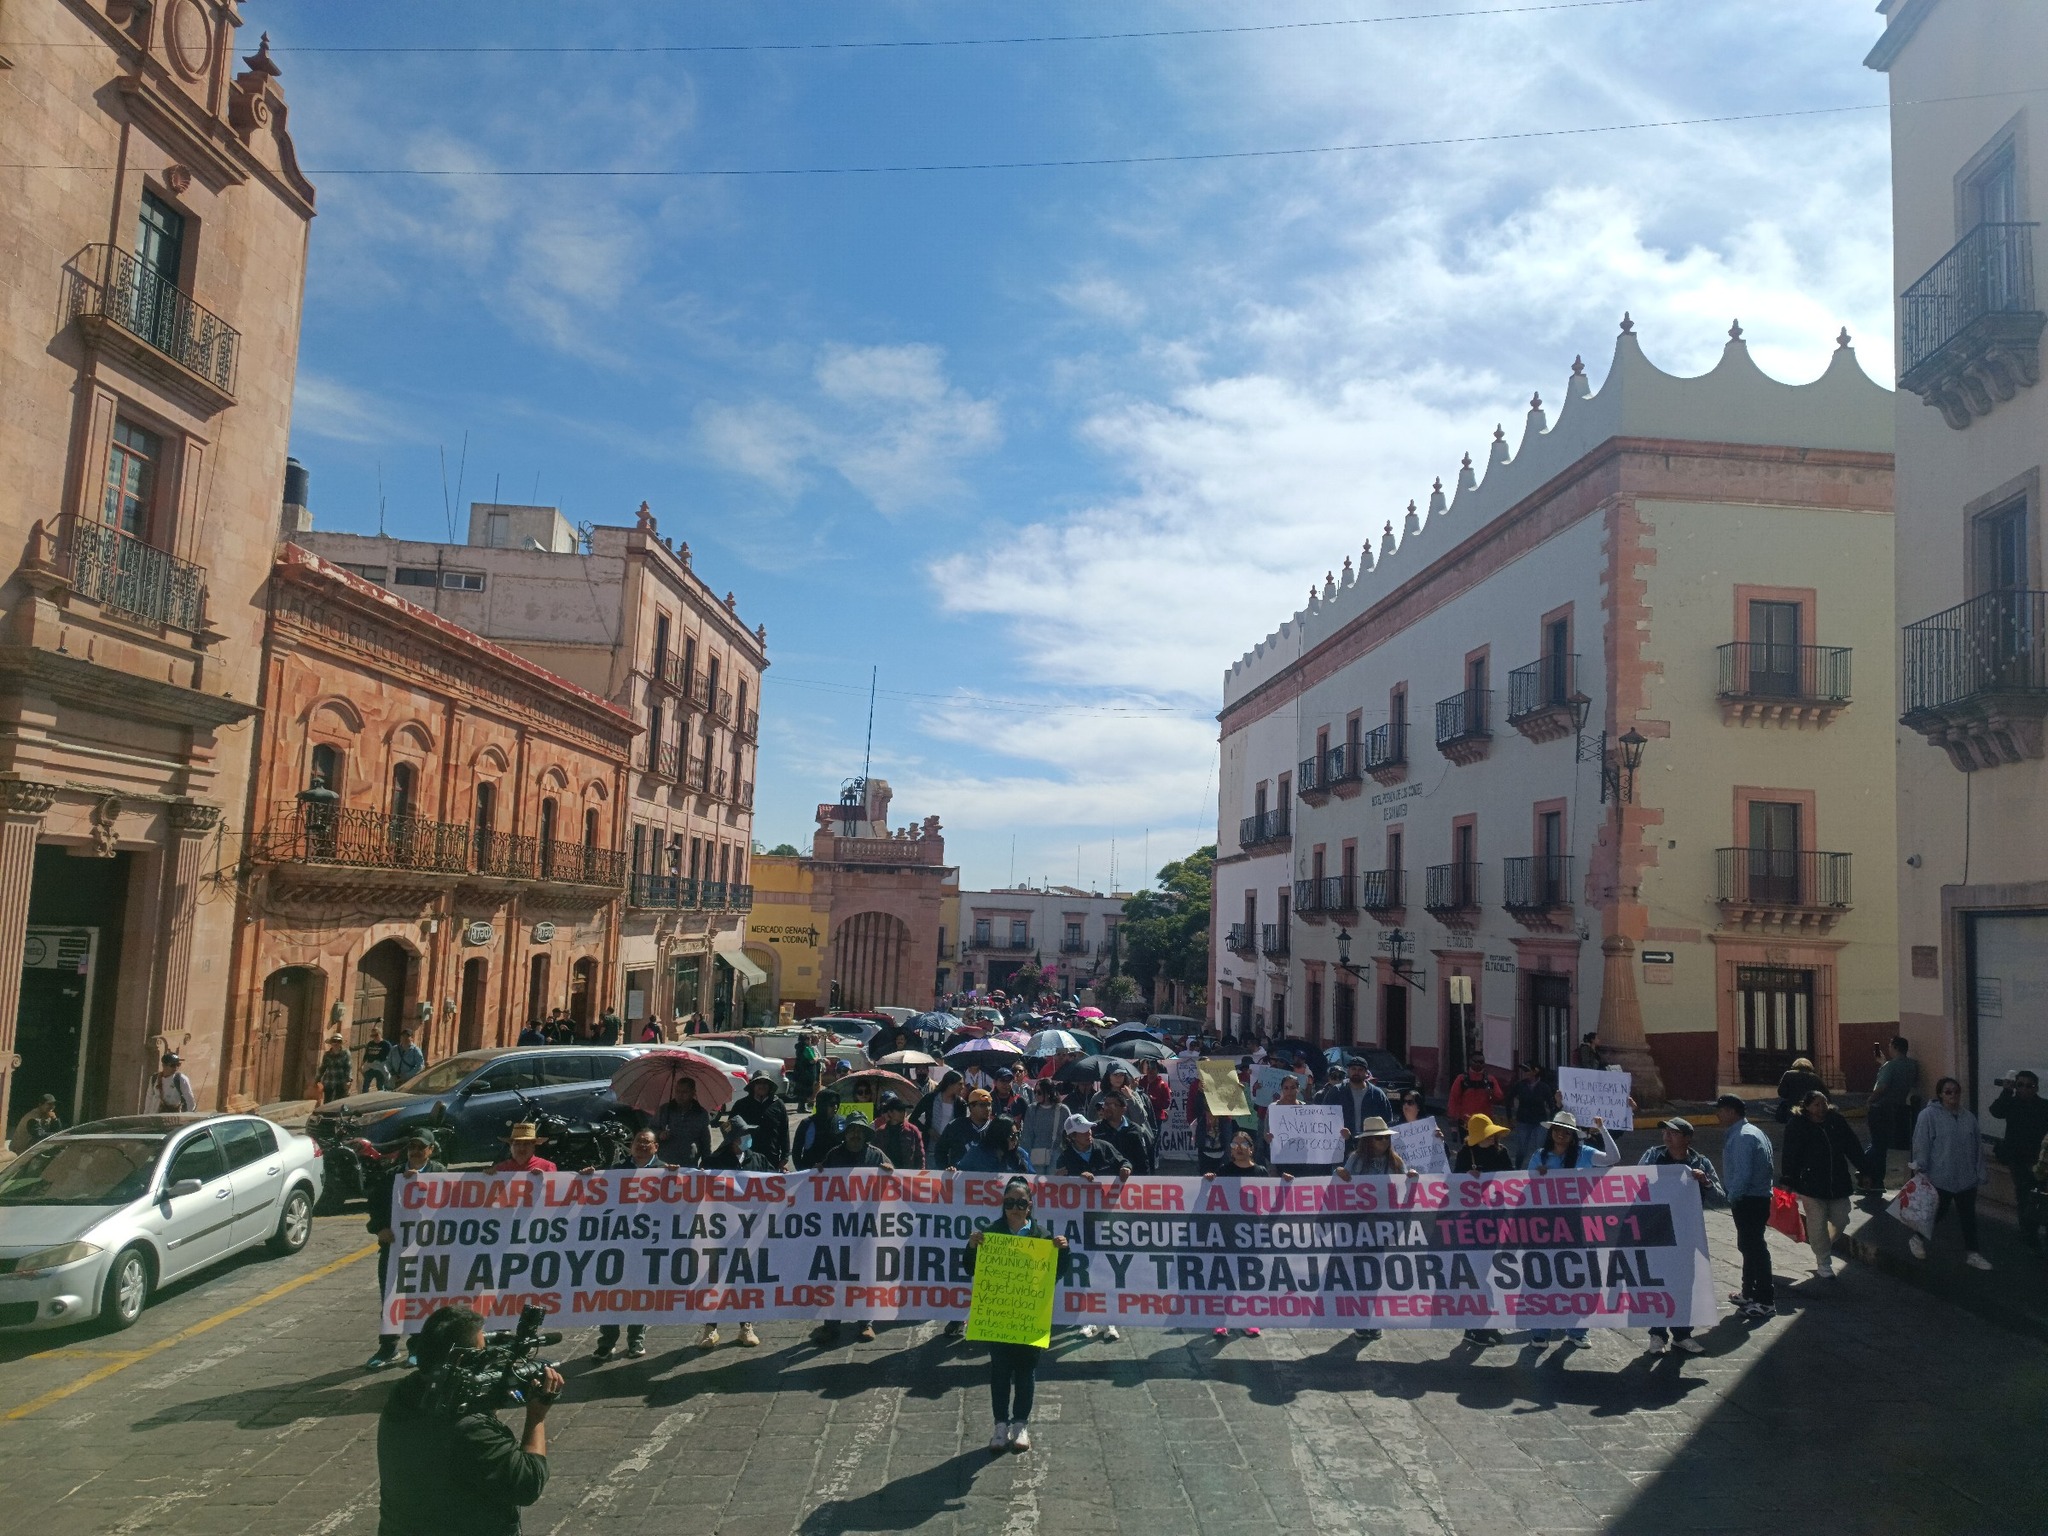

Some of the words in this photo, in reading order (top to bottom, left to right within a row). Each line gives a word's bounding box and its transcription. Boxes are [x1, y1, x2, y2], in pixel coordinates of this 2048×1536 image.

[751, 925, 783, 934] MERCADO
[403, 1179, 534, 1210] CUIDAR
[544, 1177, 609, 1207] LAS
[619, 1175, 796, 1208] ESCUELAS,
[809, 1171, 954, 1205] TAMBIÉN
[965, 1180, 1004, 1208] ES
[1206, 1185, 1230, 1212] A
[1239, 1183, 1378, 1216] QUIENES
[1387, 1181, 1450, 1210] LAS
[1459, 1174, 1652, 1209] SOSTIENEN
[400, 1218, 500, 1248] TODOS
[510, 1217, 569, 1245] LOS
[578, 1209, 661, 1245] DÍAS;
[671, 1213, 727, 1240] LAS
[738, 1213, 758, 1239] Y
[767, 1212, 821, 1239] LOS
[1094, 1220, 1226, 1248] ESCUELA
[1234, 1219, 1429, 1248] SECUNDARIA
[1436, 1210, 1574, 1245] TÉCNICA
[1625, 1214, 1641, 1241] 1
[1028, 1239, 1035, 1250] A
[396, 1254, 450, 1294] EN
[464, 1248, 625, 1291] APOYO
[642, 1247, 780, 1286] TOTAL
[808, 1245, 860, 1281] AL
[876, 1246, 1091, 1288] DIRER
[1105, 1253, 1134, 1289] Y
[1149, 1253, 1480, 1292] TRABAJADORA
[1492, 1249, 1665, 1290] SOCIAL
[978, 1253, 1051, 1272] COMUNICACIÓN
[572, 1288, 765, 1313] MODIFICAR
[775, 1285, 835, 1307] LOS
[1064, 1292, 1107, 1313] DE
[1118, 1291, 1325, 1316] PROTECCIÓN
[1335, 1294, 1500, 1317] INTEGRAL
[1504, 1291, 1676, 1319] ESCOLAR)
